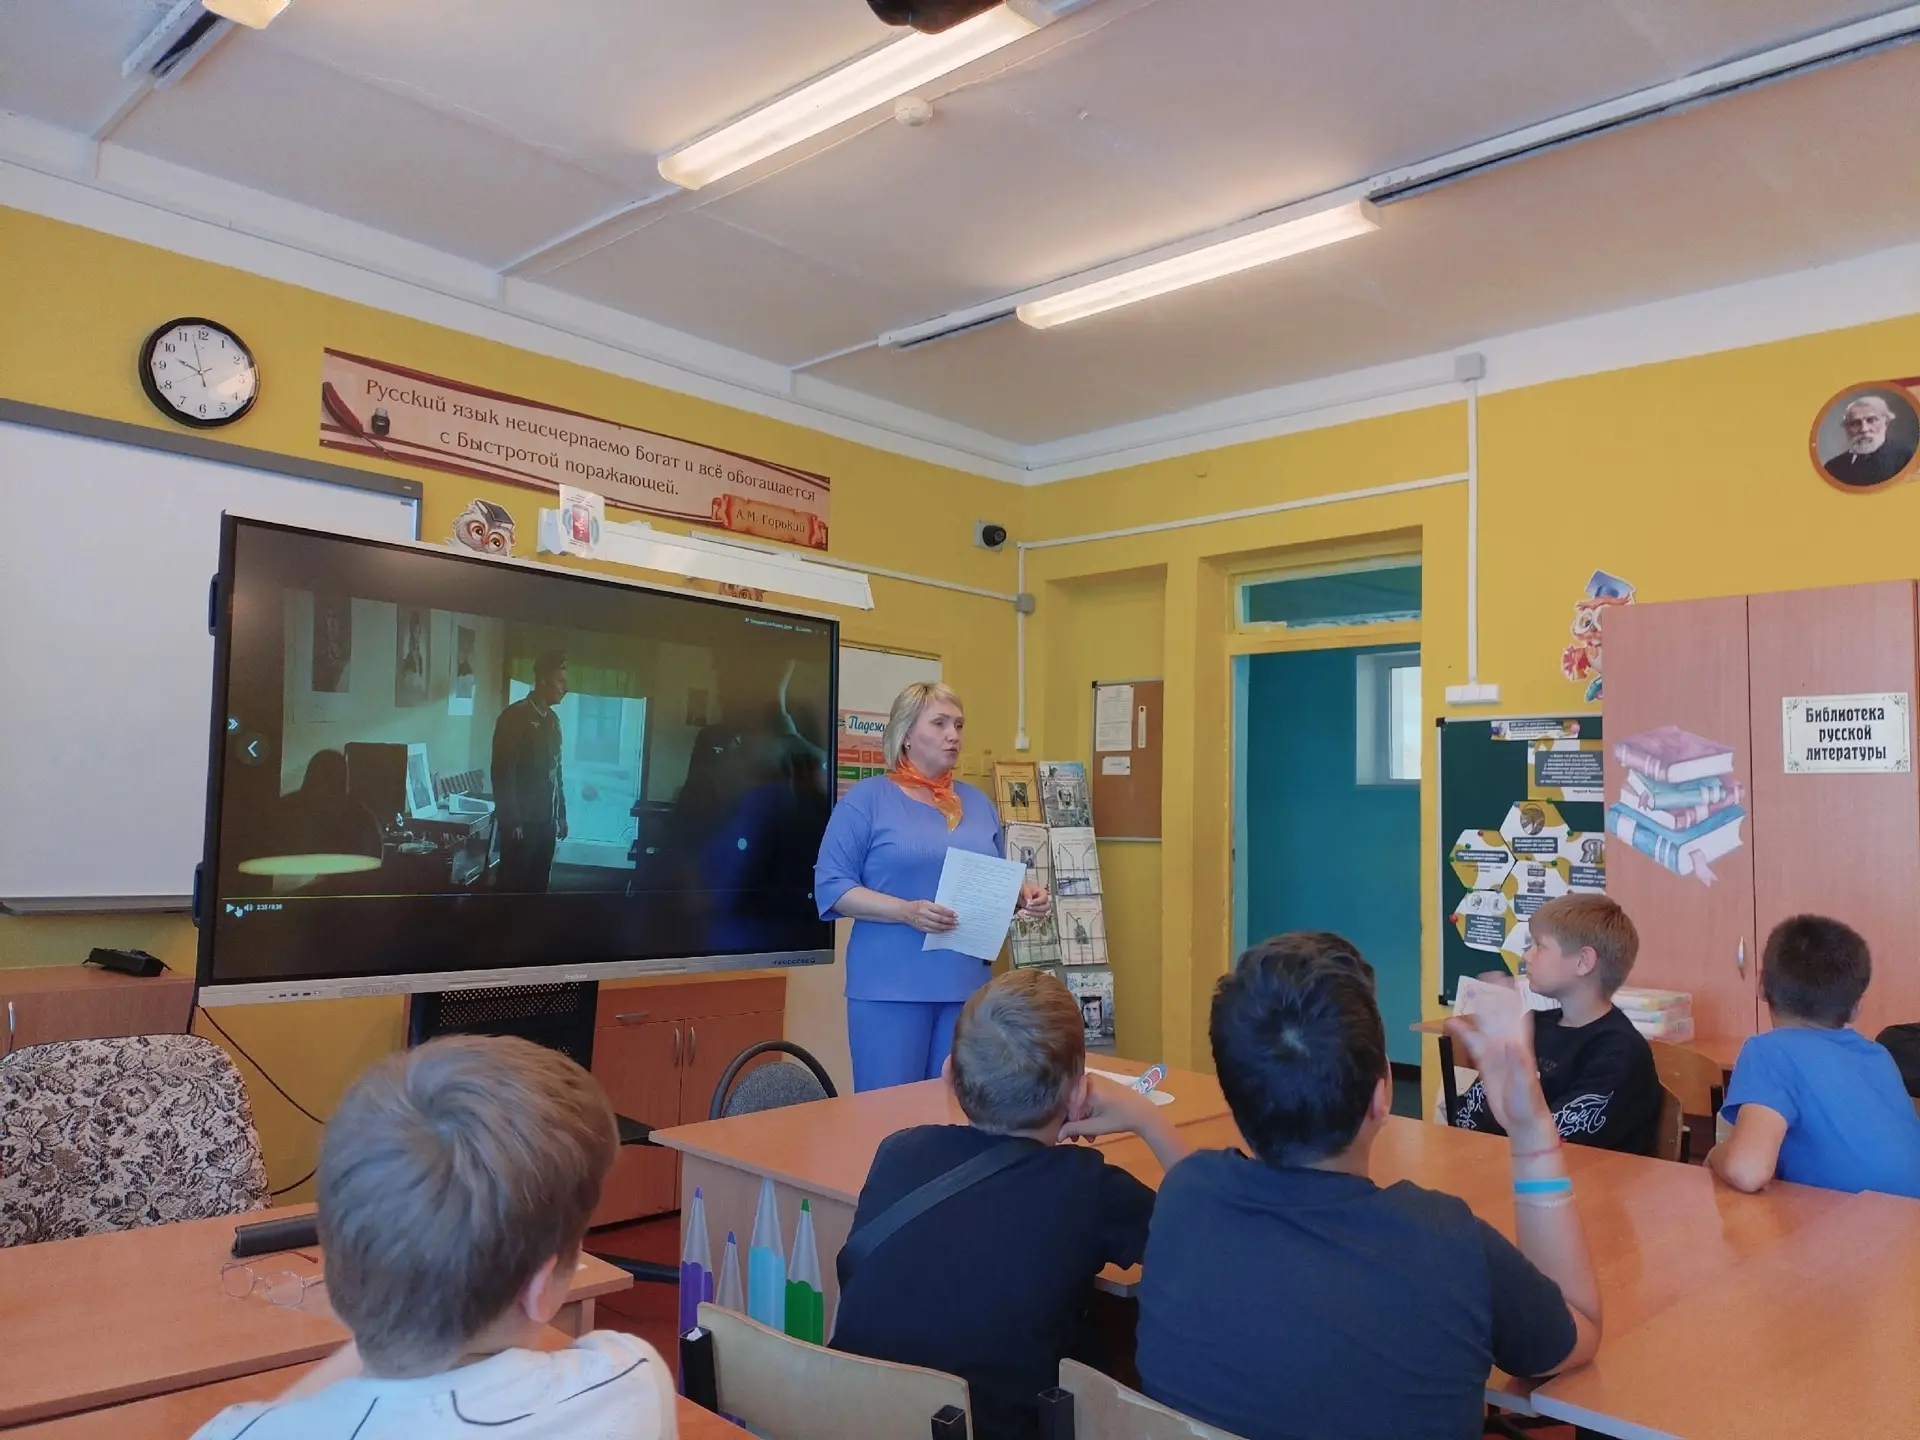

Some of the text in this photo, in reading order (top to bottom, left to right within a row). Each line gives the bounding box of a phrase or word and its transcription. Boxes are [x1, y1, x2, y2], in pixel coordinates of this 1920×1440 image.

[178, 331, 188, 342] 11
[198, 330, 209, 341] 12
[165, 342, 176, 353] 10
[221, 340, 225, 349] 1
[159, 360, 167, 370] 9
[233, 355, 240, 365] 2
[164, 380, 172, 390] 8
[179, 395, 187, 405] 7
[199, 403, 207, 414] 6
[219, 402, 227, 412] 5
[366, 379, 815, 502] Русский язык неисчерпаемо богат и всё обогащается
[440, 431, 679, 495] с быстротой поражающей.
[761, 514, 805, 533] Горький
[1805, 707, 1885, 723] Библиотека
[848, 715, 885, 734] Падеж
[1818, 724, 1872, 743] русской
[1806, 746, 1887, 762] литературы
